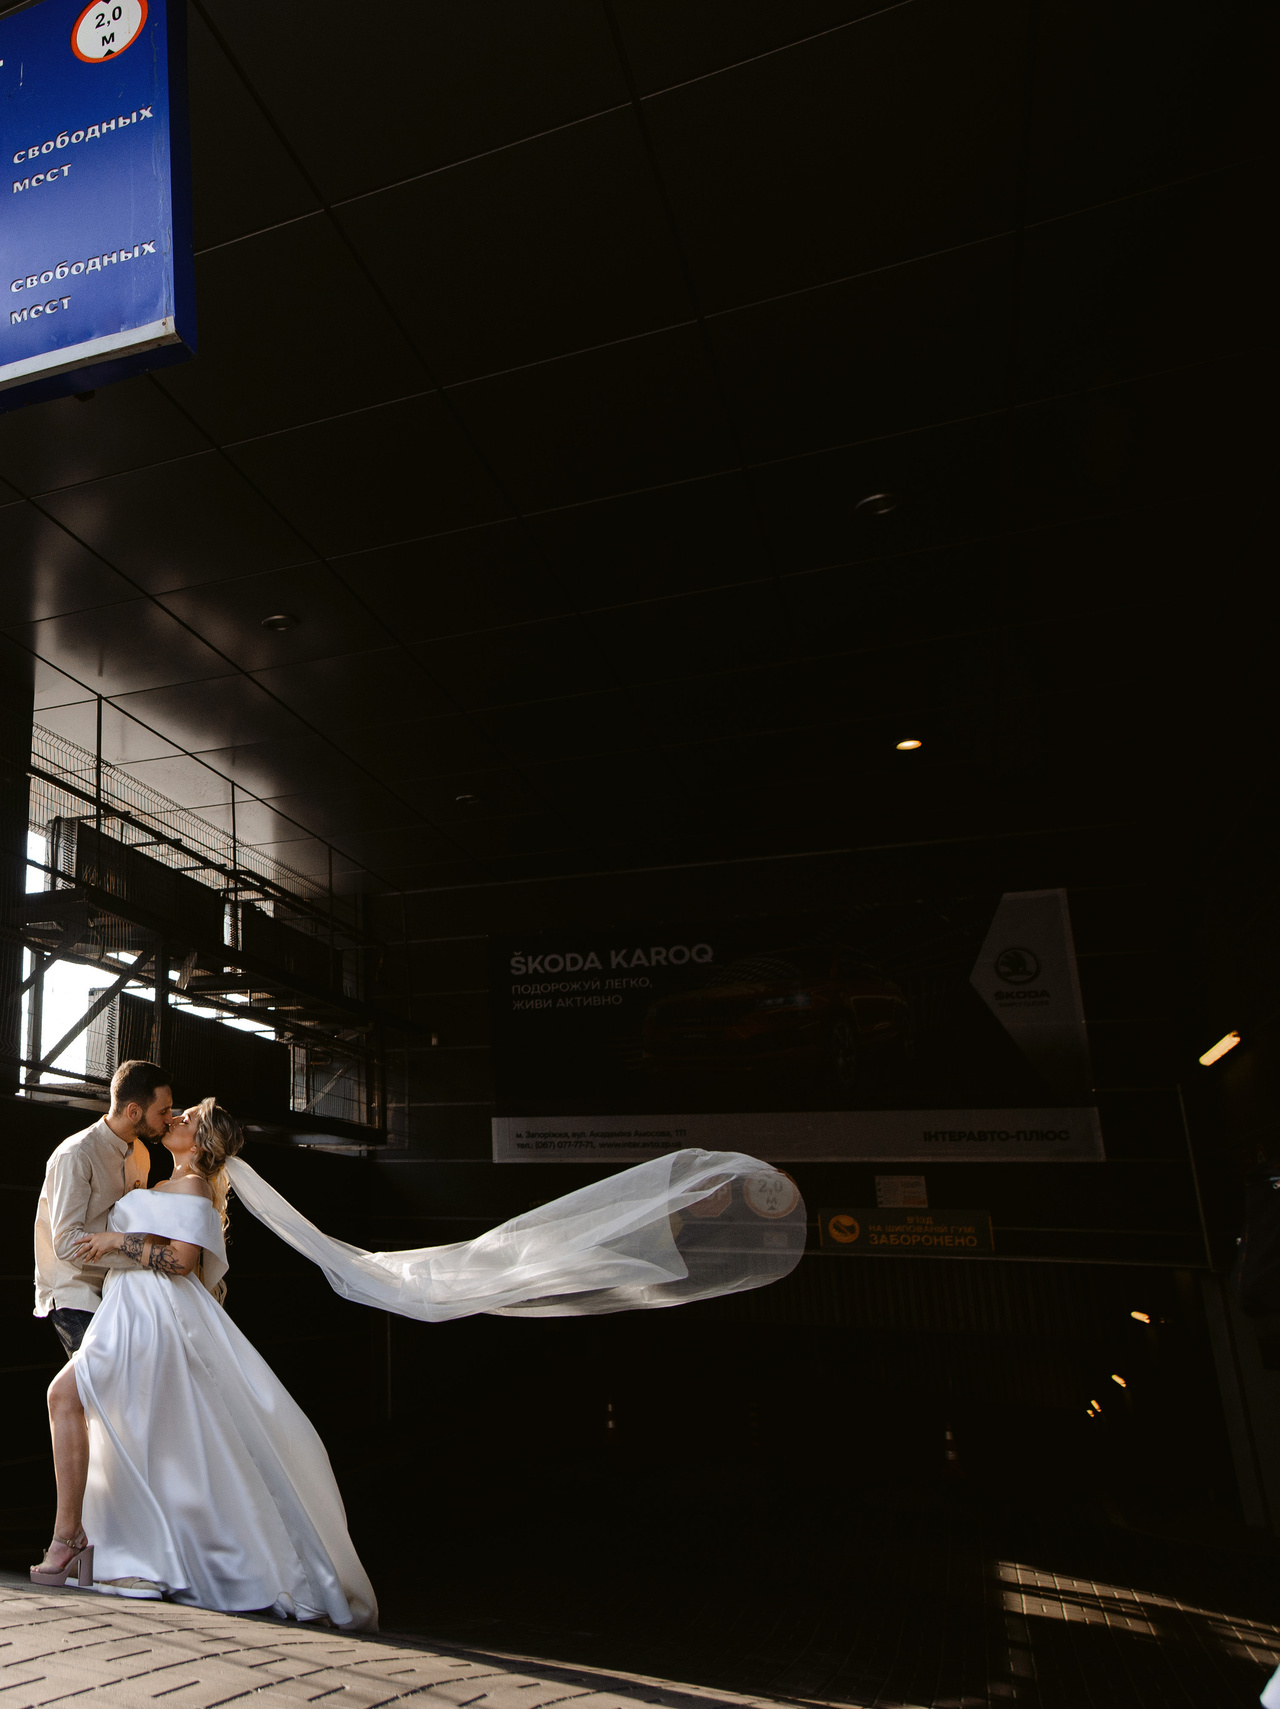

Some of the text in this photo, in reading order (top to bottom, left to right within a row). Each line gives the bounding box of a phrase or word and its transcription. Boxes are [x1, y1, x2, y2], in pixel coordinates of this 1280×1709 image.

[95, 6, 122, 29] 2,0
[12, 104, 154, 165] свободных
[12, 162, 73, 194] мест
[10, 239, 157, 294] свободных
[10, 295, 72, 326] мест
[510, 943, 714, 976] ŠKODA KAROQ
[511, 976, 653, 996] ПОДОРОЖУЙ ЛЕГКО,
[512, 993, 624, 1011] ЖИВИ АКТИВНО
[923, 1129, 1070, 1142] ІНТЕРАВТО-ПЛЮС
[868, 1233, 978, 1248] ЗАБОРОНЕНО
